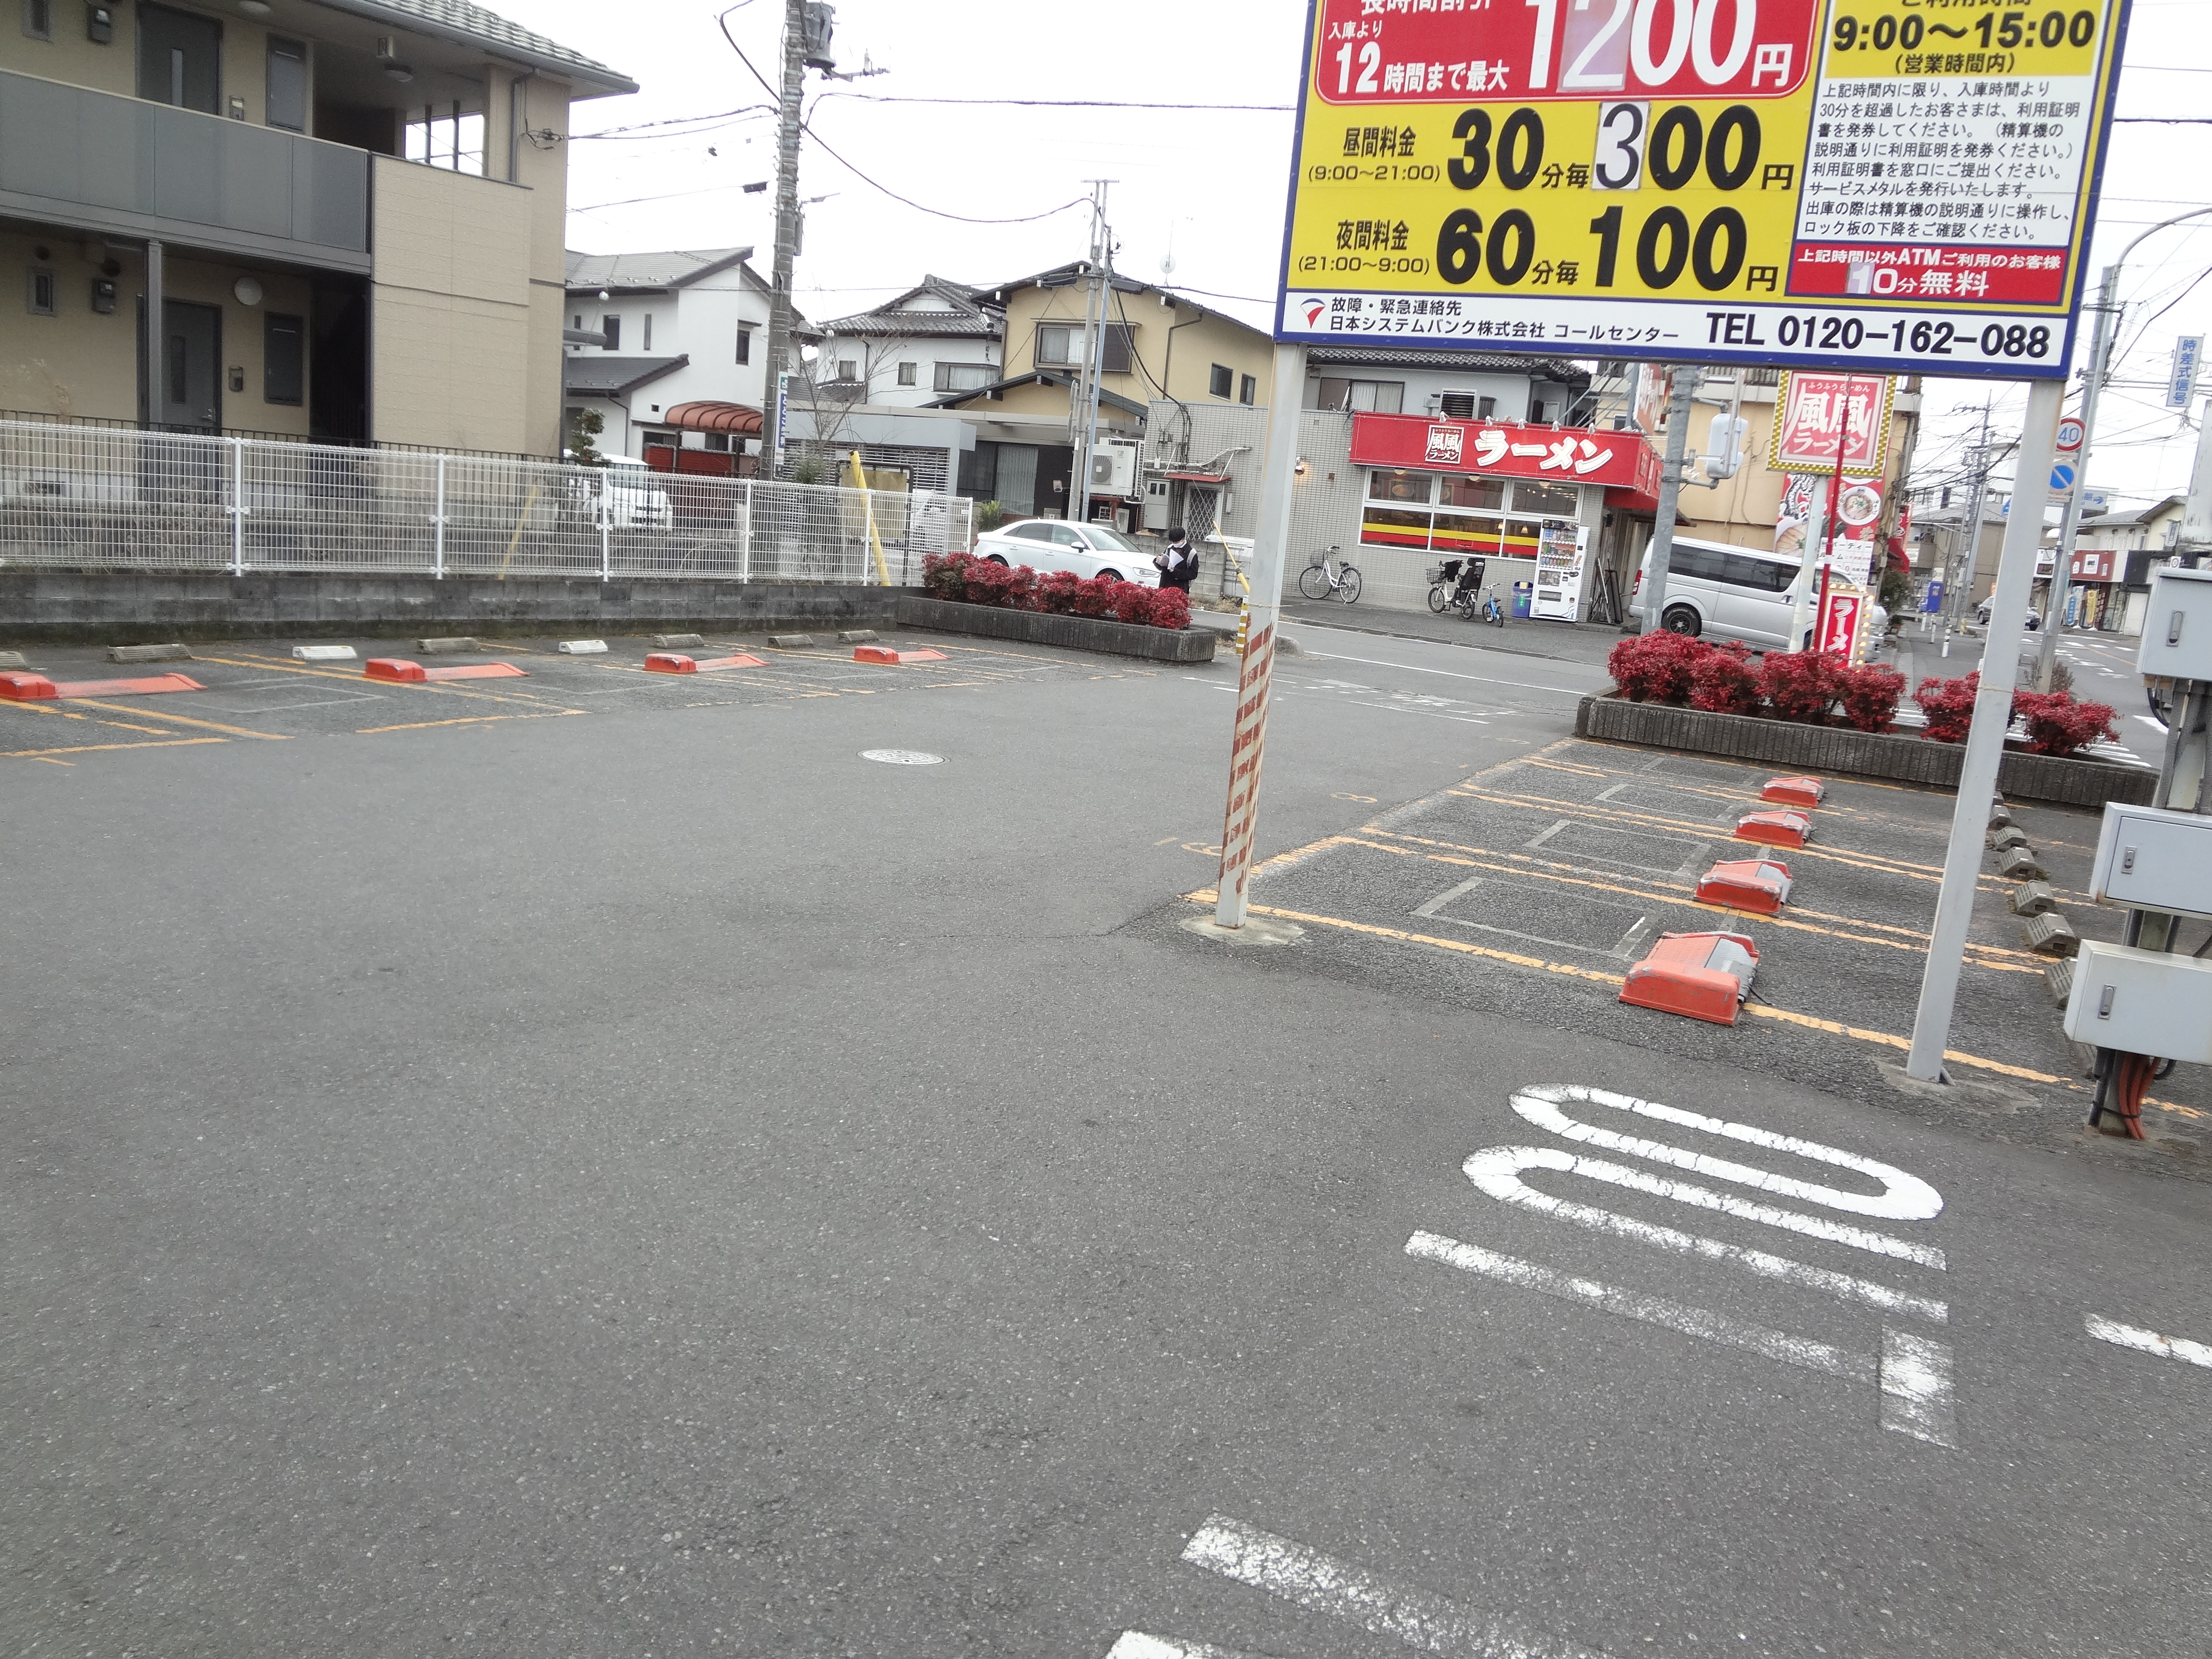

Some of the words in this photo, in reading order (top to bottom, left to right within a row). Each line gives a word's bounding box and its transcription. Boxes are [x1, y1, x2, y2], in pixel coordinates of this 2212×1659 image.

[1328, 20, 1382, 40] 入庫より
[1336, 41, 1510, 94] 12時間まで最大
[1526, 0, 1793, 89] 1200円
[1343, 125, 1416, 157] 昼間料金
[1448, 108, 1589, 191] 30分毎
[1596, 103, 1794, 191] 300円
[1812, 161, 2060, 179] 利用証明書を窓口にご提出ください。
[1809, 181, 2032, 199] サービスメタルを発行いたします。
[1806, 200, 2069, 220] 出庫の際は精算機の説明通りに操作し、
[1336, 219, 1409, 251] 夜間料金
[1804, 220, 2034, 240] ロック板の下降をご確認ください。
[1437, 208, 1579, 286] 60分毎
[1590, 205, 1779, 291] 100円
[1798, 248, 2061, 270] 上記時間以外ATMご利用のお客様
[1851, 264, 1989, 297] 10分無料
[1332, 297, 1462, 316] 故障・緊急連絡先
[1330, 316, 1545, 339] 日本システムバンク株式会社
[1555, 324, 1679, 342] コールセンター
[1706, 312, 1765, 346] TEL
[1778, 315, 2051, 359] 0120-162-088
[2173, 339, 2197, 404] 時差式信号
[1781, 382, 1873, 448] 風風
[1425, 429, 1461, 457] 風風
[1793, 431, 1864, 456] ラーメン
[2058, 427, 2080, 442] 40
[1430, 449, 1458, 460] ラーメン
[1474, 429, 1613, 474] ラーメン
[1827, 599, 1854, 662] ラーメ
